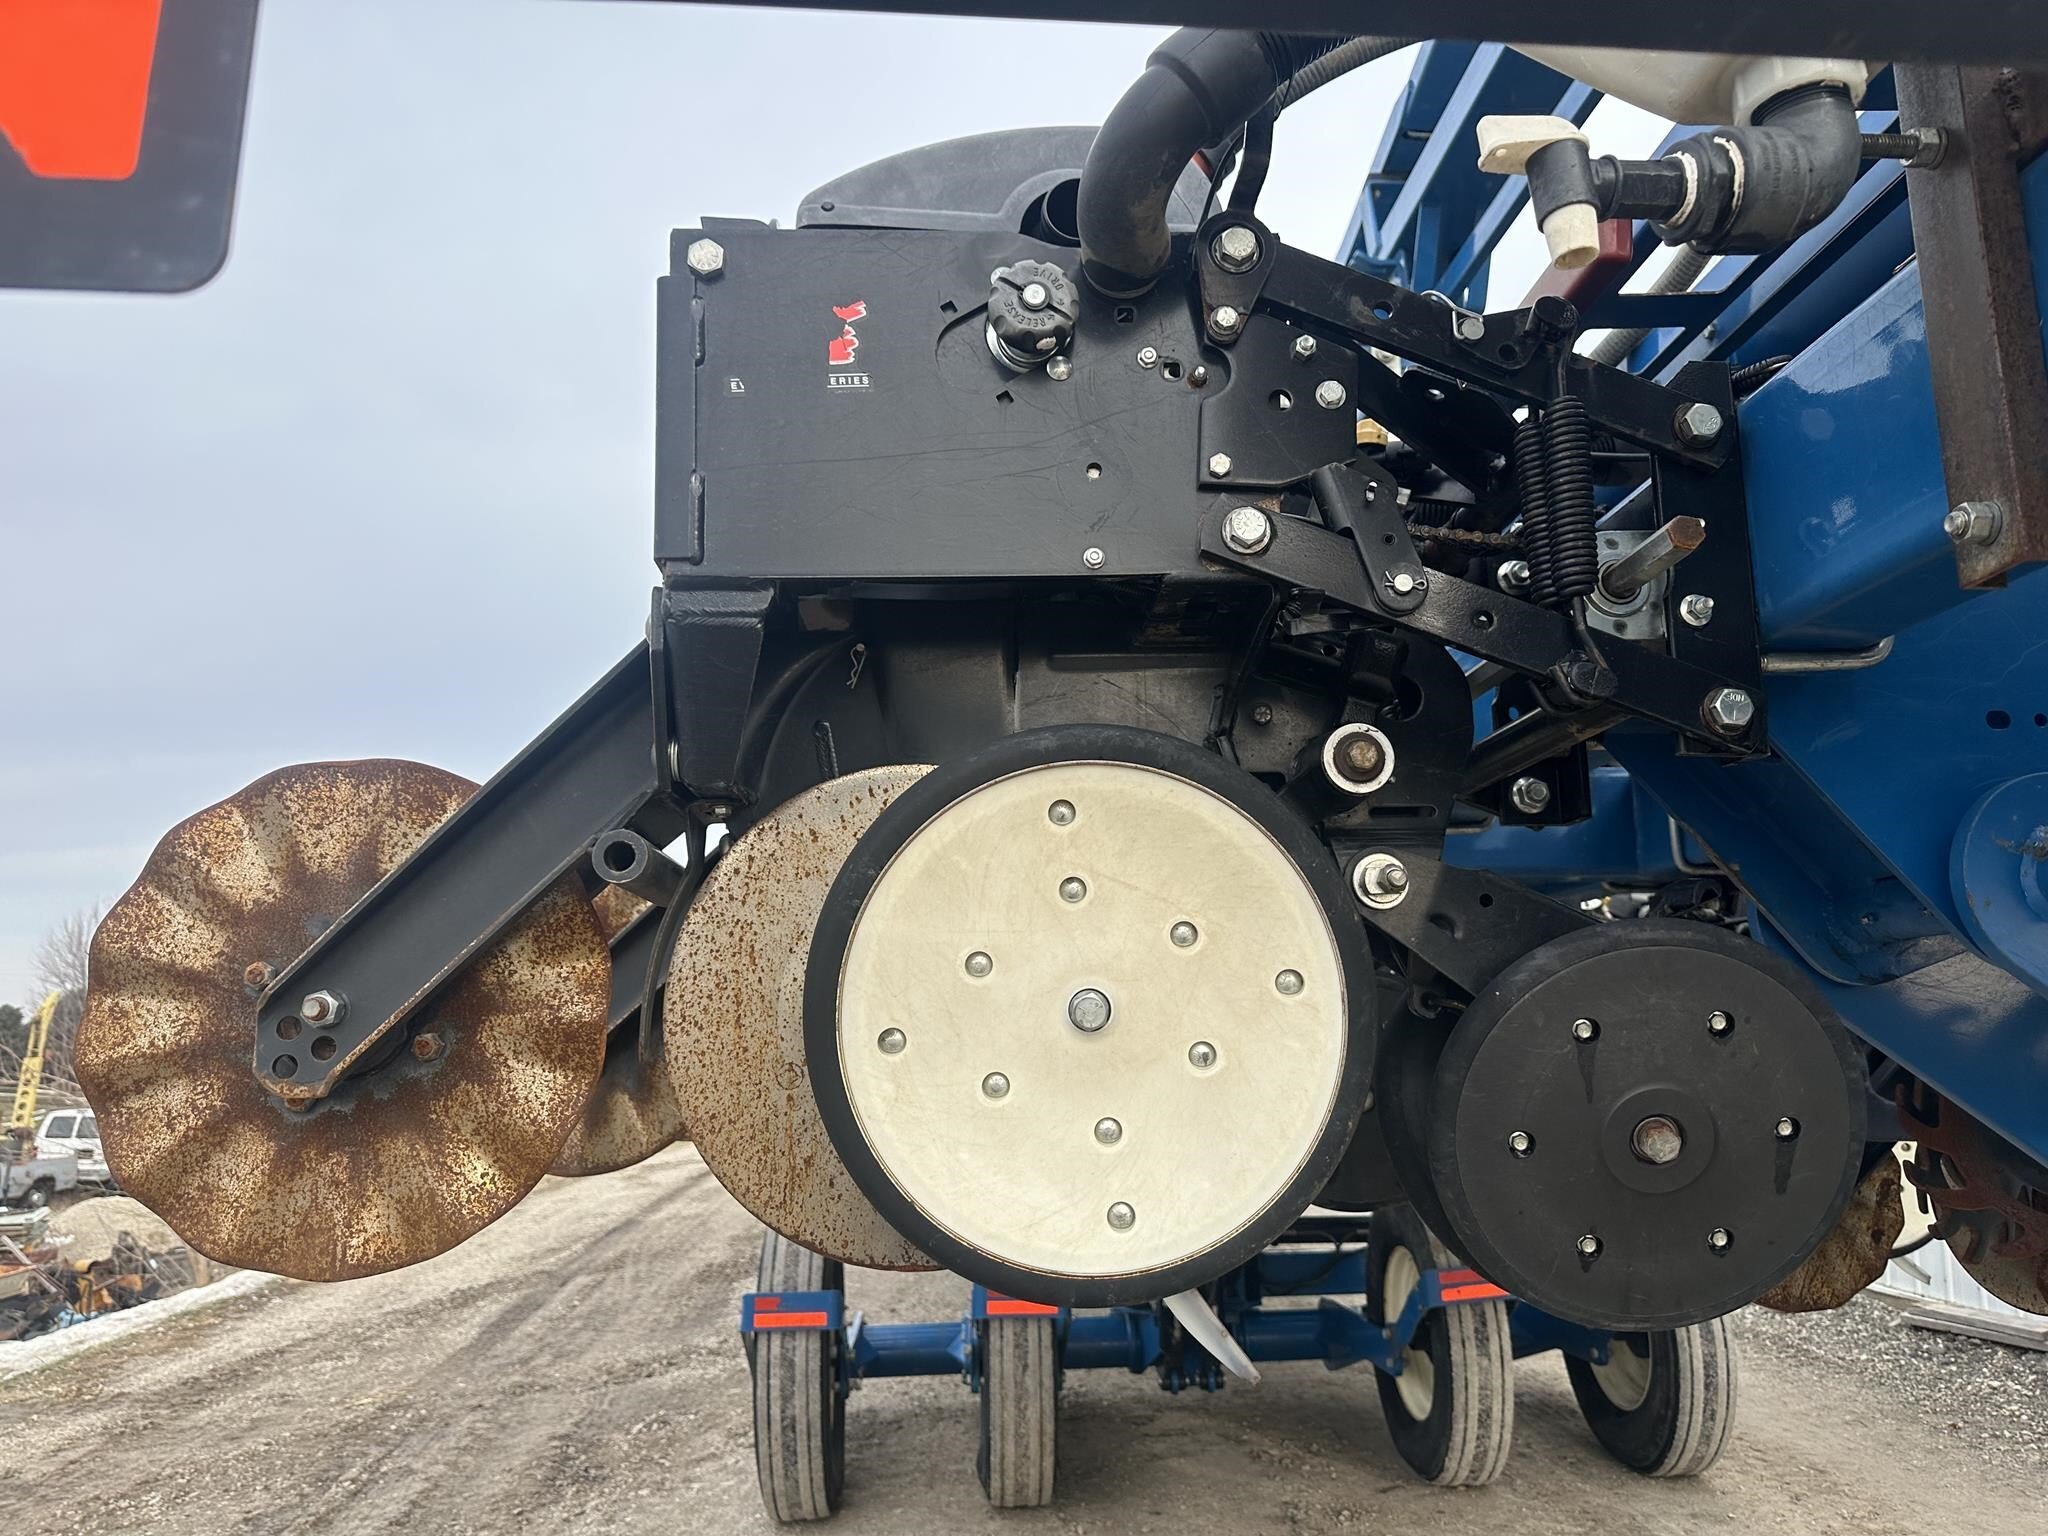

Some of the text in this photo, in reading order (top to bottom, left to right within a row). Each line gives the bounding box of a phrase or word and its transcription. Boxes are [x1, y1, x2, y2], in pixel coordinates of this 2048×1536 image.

[1032, 267, 1065, 292] DRIVE
[1003, 299, 1047, 328] RELEASE
[830, 376, 870, 385] ERIES
